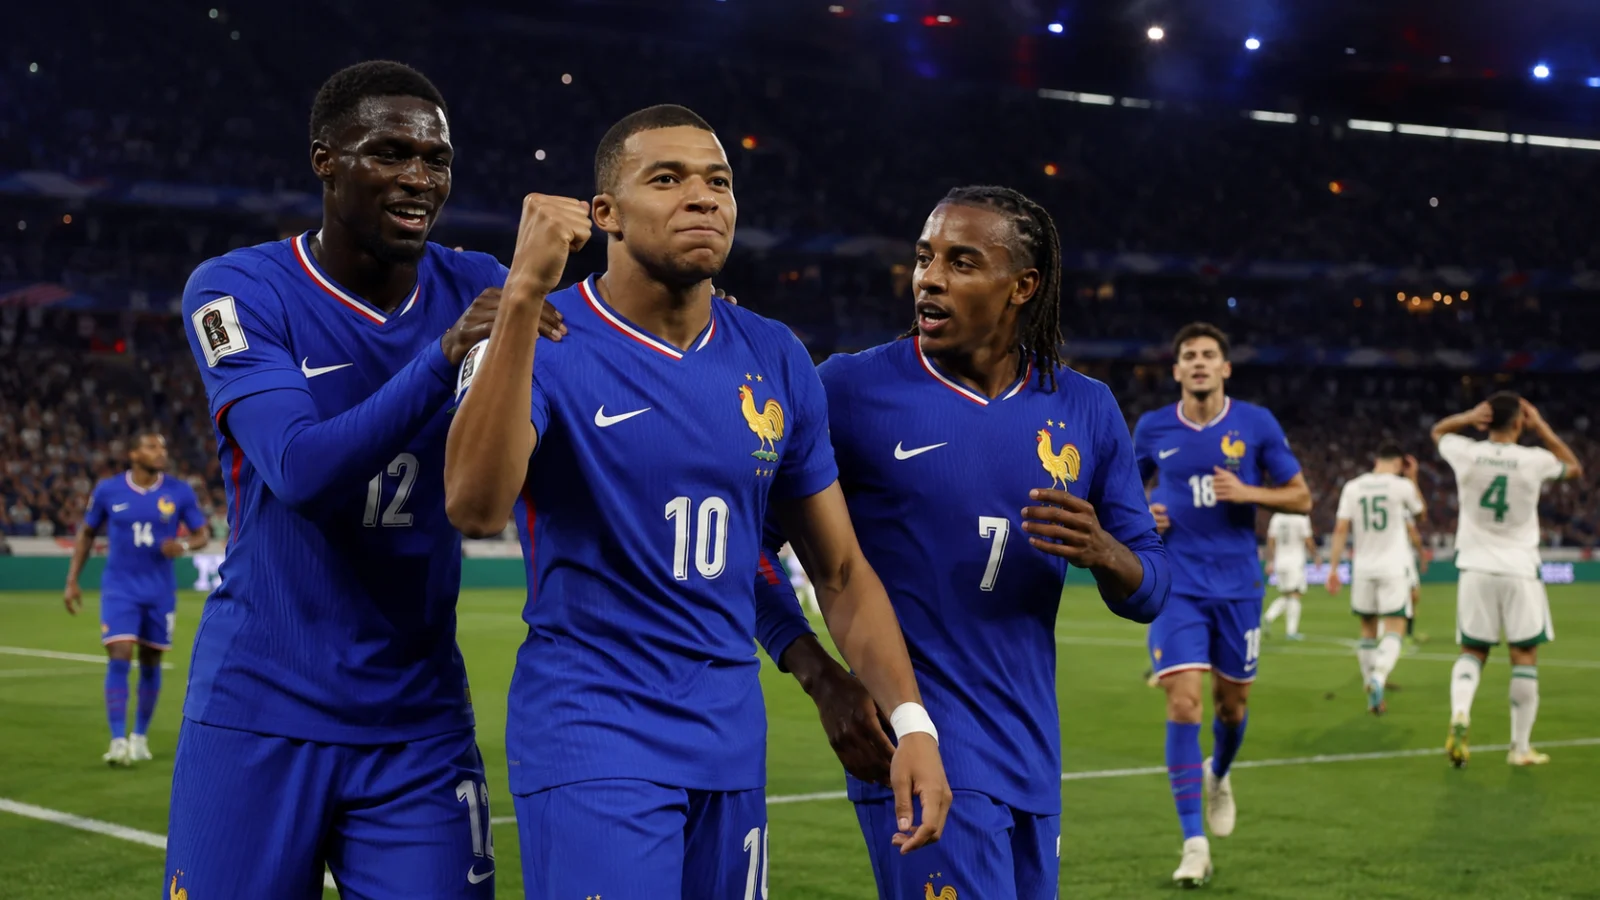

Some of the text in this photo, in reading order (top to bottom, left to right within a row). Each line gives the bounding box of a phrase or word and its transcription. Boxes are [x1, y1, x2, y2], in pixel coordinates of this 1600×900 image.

[362, 452, 418, 528] 12
[1188, 474, 1217, 508] 18
[1358, 495, 1388, 532] 15
[1479, 474, 1509, 523] 4
[132, 521, 154, 548] 14
[665, 496, 730, 580] 10
[979, 516, 1010, 591] 7
